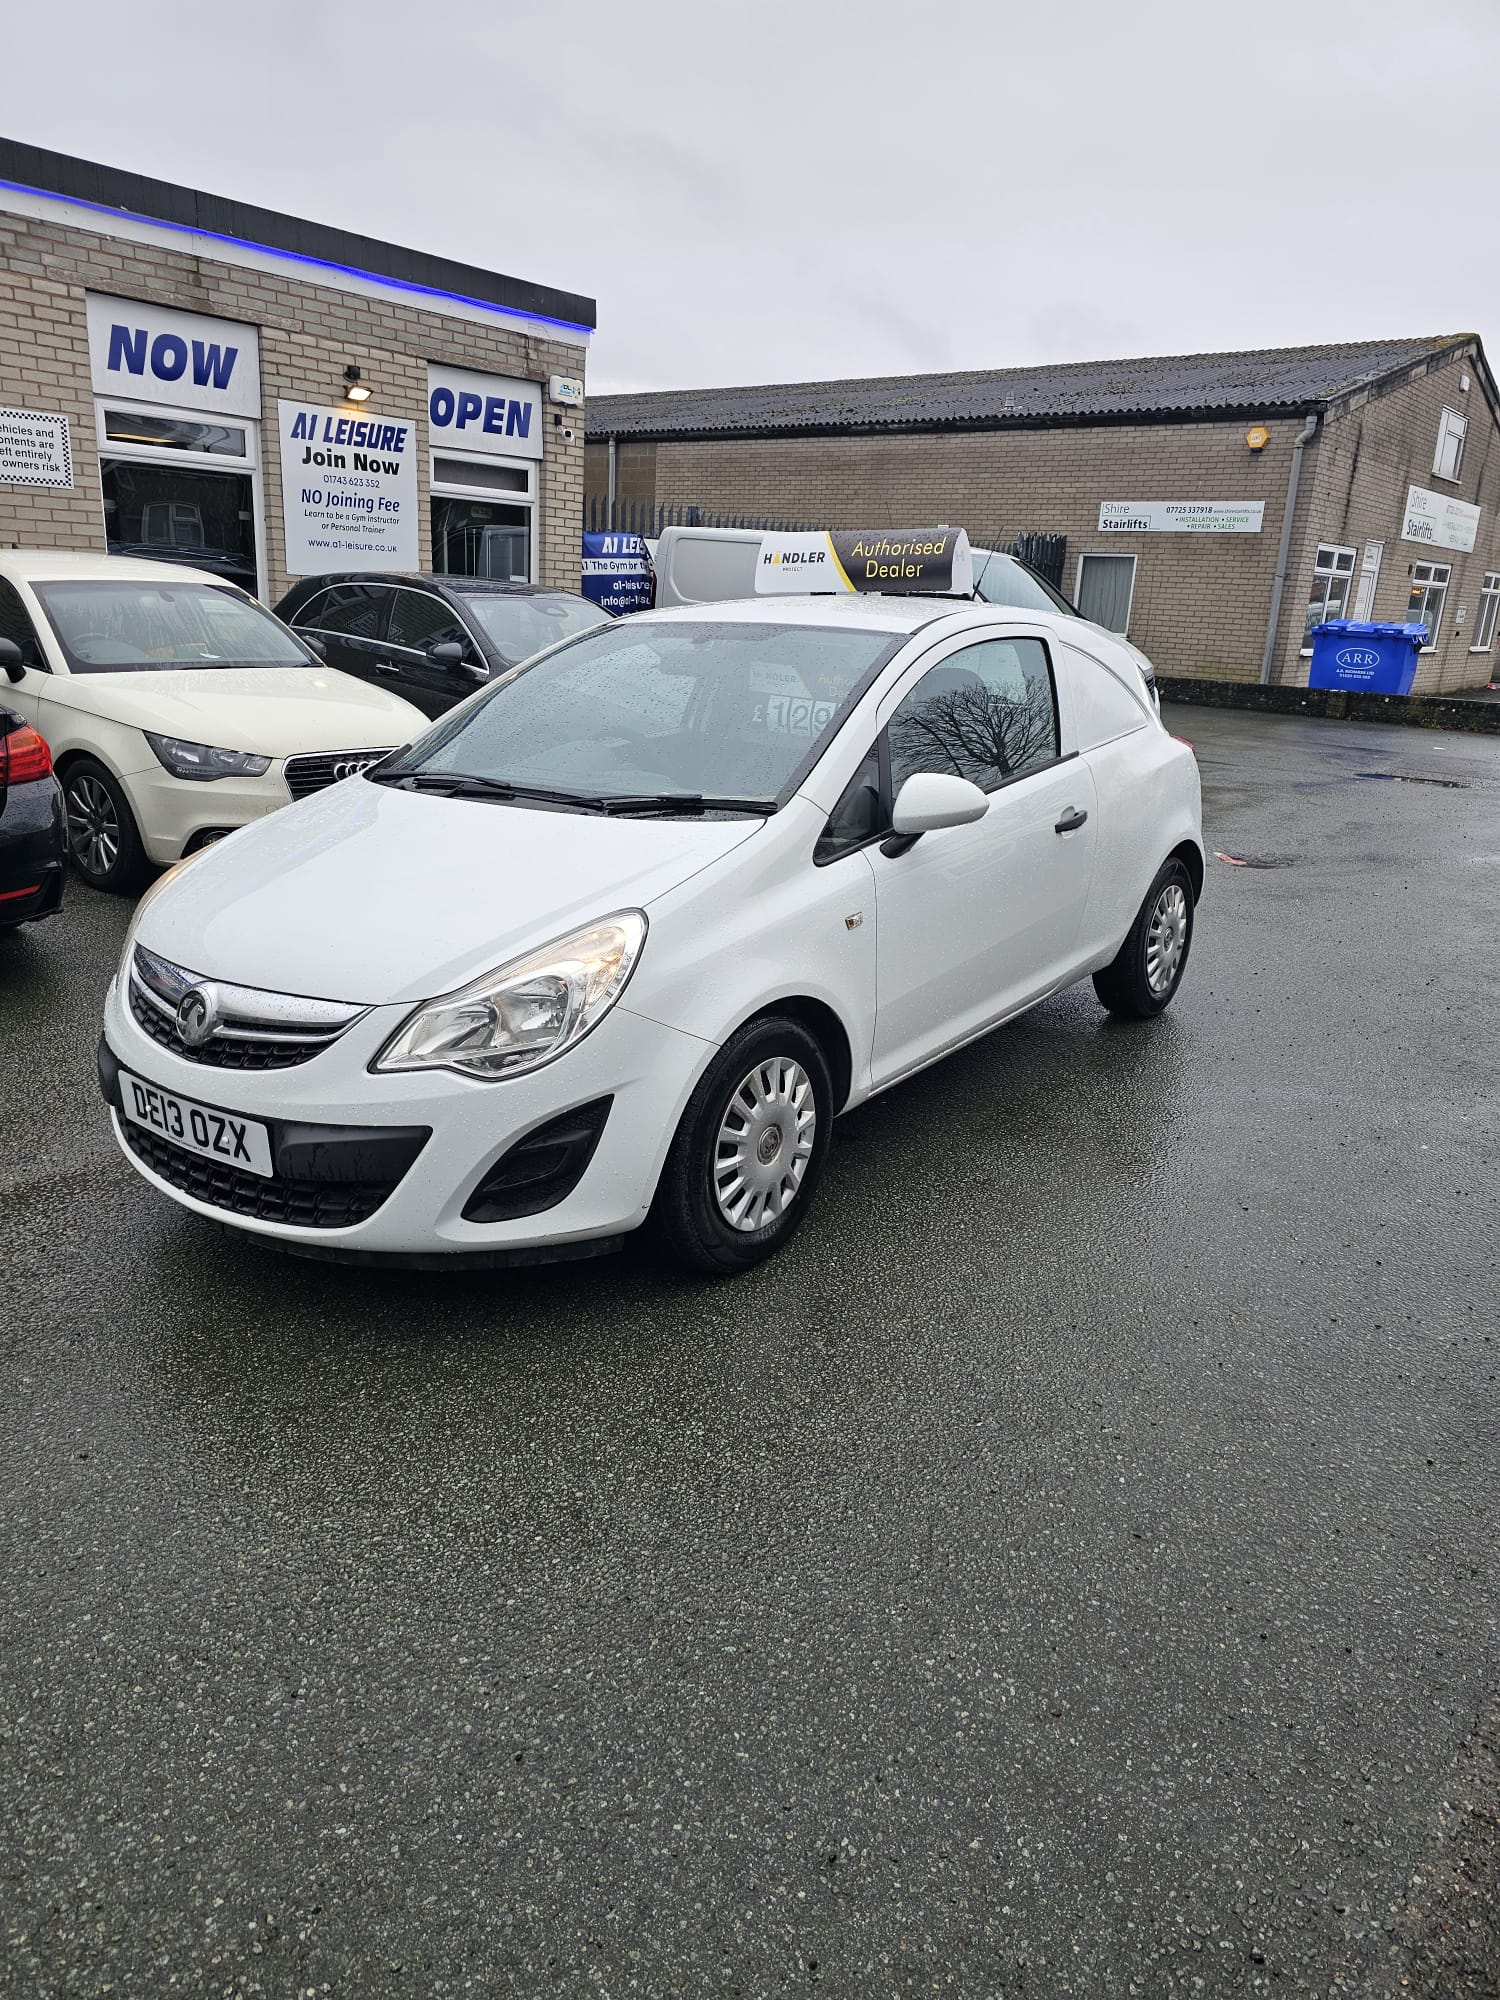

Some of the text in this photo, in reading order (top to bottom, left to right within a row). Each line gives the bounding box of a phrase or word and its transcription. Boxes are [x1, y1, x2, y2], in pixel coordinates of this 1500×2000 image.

[108, 324, 238, 390] NOW
[430, 387, 532, 438] OPEN
[36, 429, 54, 438] and
[291, 412, 408, 453] A1 LEISURE
[39, 441, 54, 449] are
[15, 449, 52, 462] entirely
[302, 446, 400, 475] Join Now
[2, 460, 61, 472] owners risk
[323, 475, 380, 489] 01743 623 352
[301, 488, 400, 513] NO Joining Fee
[1104, 503, 1130, 514] Shire
[1166, 506, 1187, 514] 07725
[1187, 506, 1213, 514] 337918
[304, 509, 325, 519] Learn
[326, 511, 334, 519] to
[335, 512, 344, 520] be
[351, 513, 366, 523] Gym
[330, 522, 361, 533] Personal
[362, 525, 386, 534] Trainer
[1102, 519, 1148, 529] Stairlifts
[1406, 519, 1433, 540] Stairlifts
[308, 539, 397, 552] www.a1-leisure.co.uk
[852, 537, 947, 557] Authorised
[866, 560, 923, 578] Dealer
[1341, 652, 1373, 664] ARR
[131, 1082, 251, 1163] DE13 OZX
